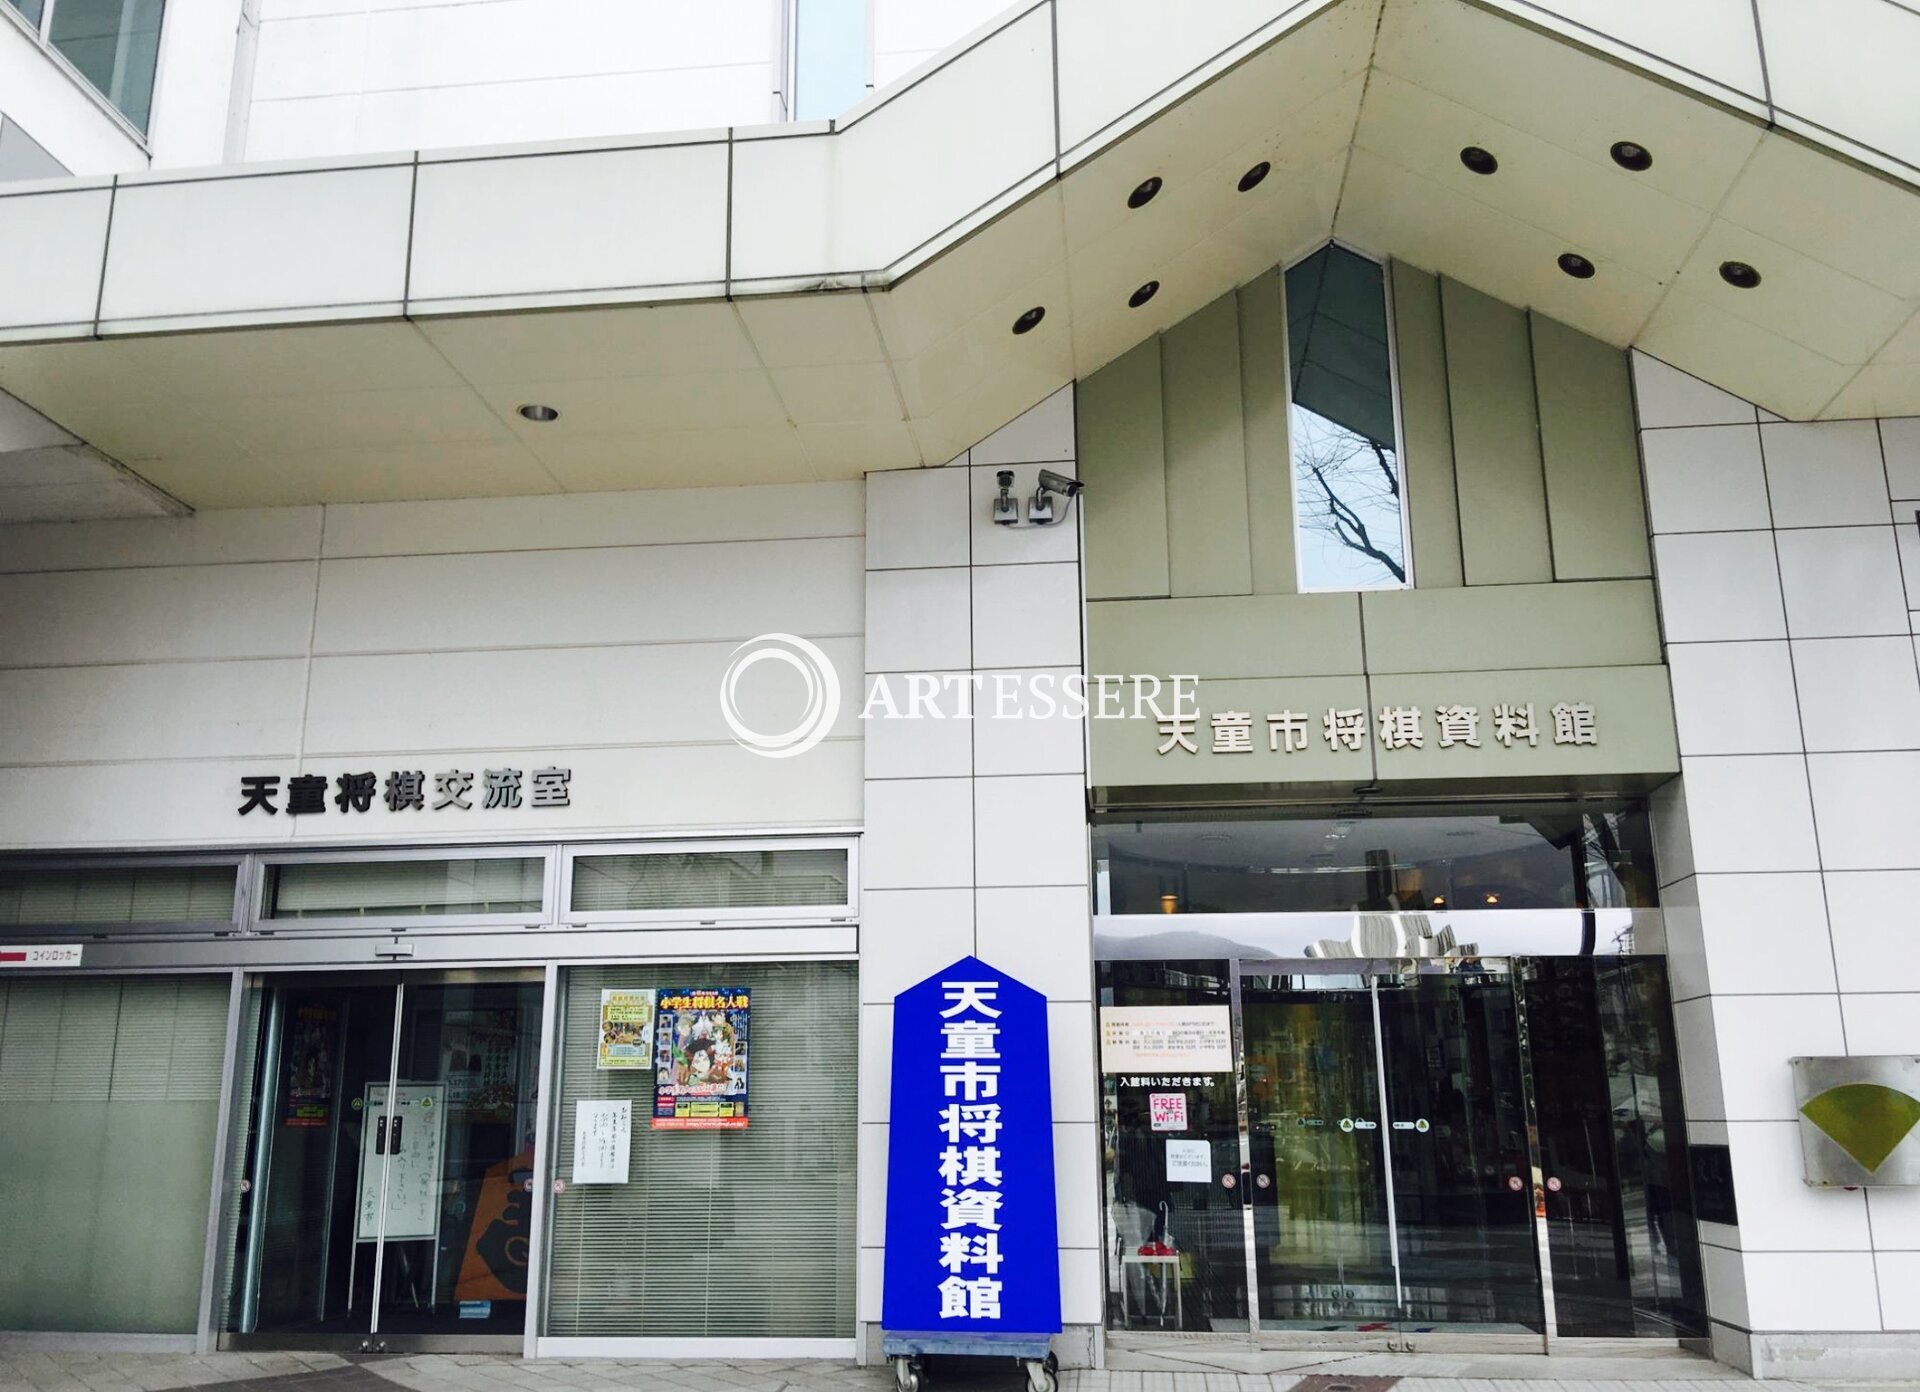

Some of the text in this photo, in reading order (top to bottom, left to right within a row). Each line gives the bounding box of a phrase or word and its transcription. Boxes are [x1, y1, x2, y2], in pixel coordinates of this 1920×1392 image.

[1156, 702, 1599, 756] 天童市将棋資料館
[237, 766, 571, 815] 天童将棋交流室
[33, 950, 79, 961] コインロッカー
[1120, 1076, 1215, 1088] 入館料いただきます。
[1153, 1097, 1183, 1110] FREE
[1154, 1111, 1184, 1122] Wi-Fi
[938, 981, 1004, 1319] 天童市将棋資料館
